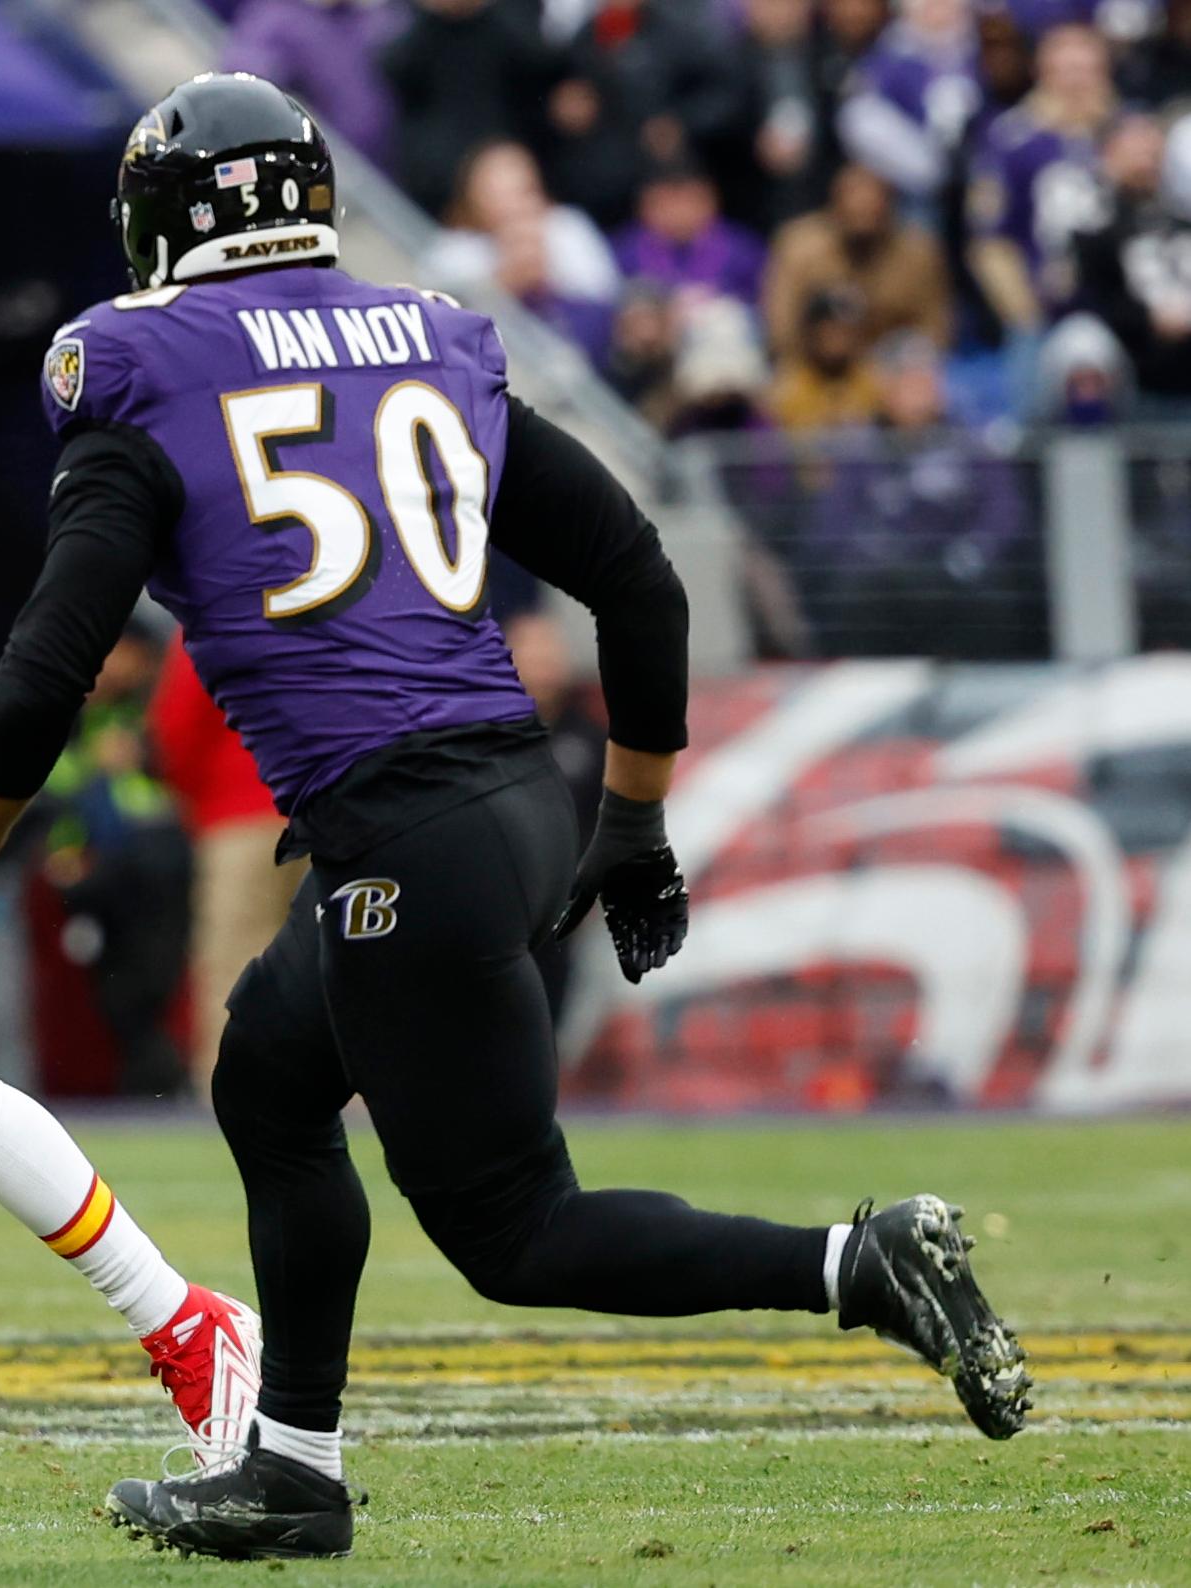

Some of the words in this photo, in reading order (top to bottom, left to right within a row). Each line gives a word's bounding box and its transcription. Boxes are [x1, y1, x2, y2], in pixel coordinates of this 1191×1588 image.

[220, 235, 321, 261] RAVENS
[237, 308, 338, 370] VAN
[332, 303, 432, 367] NOY
[220, 379, 489, 616] 50
